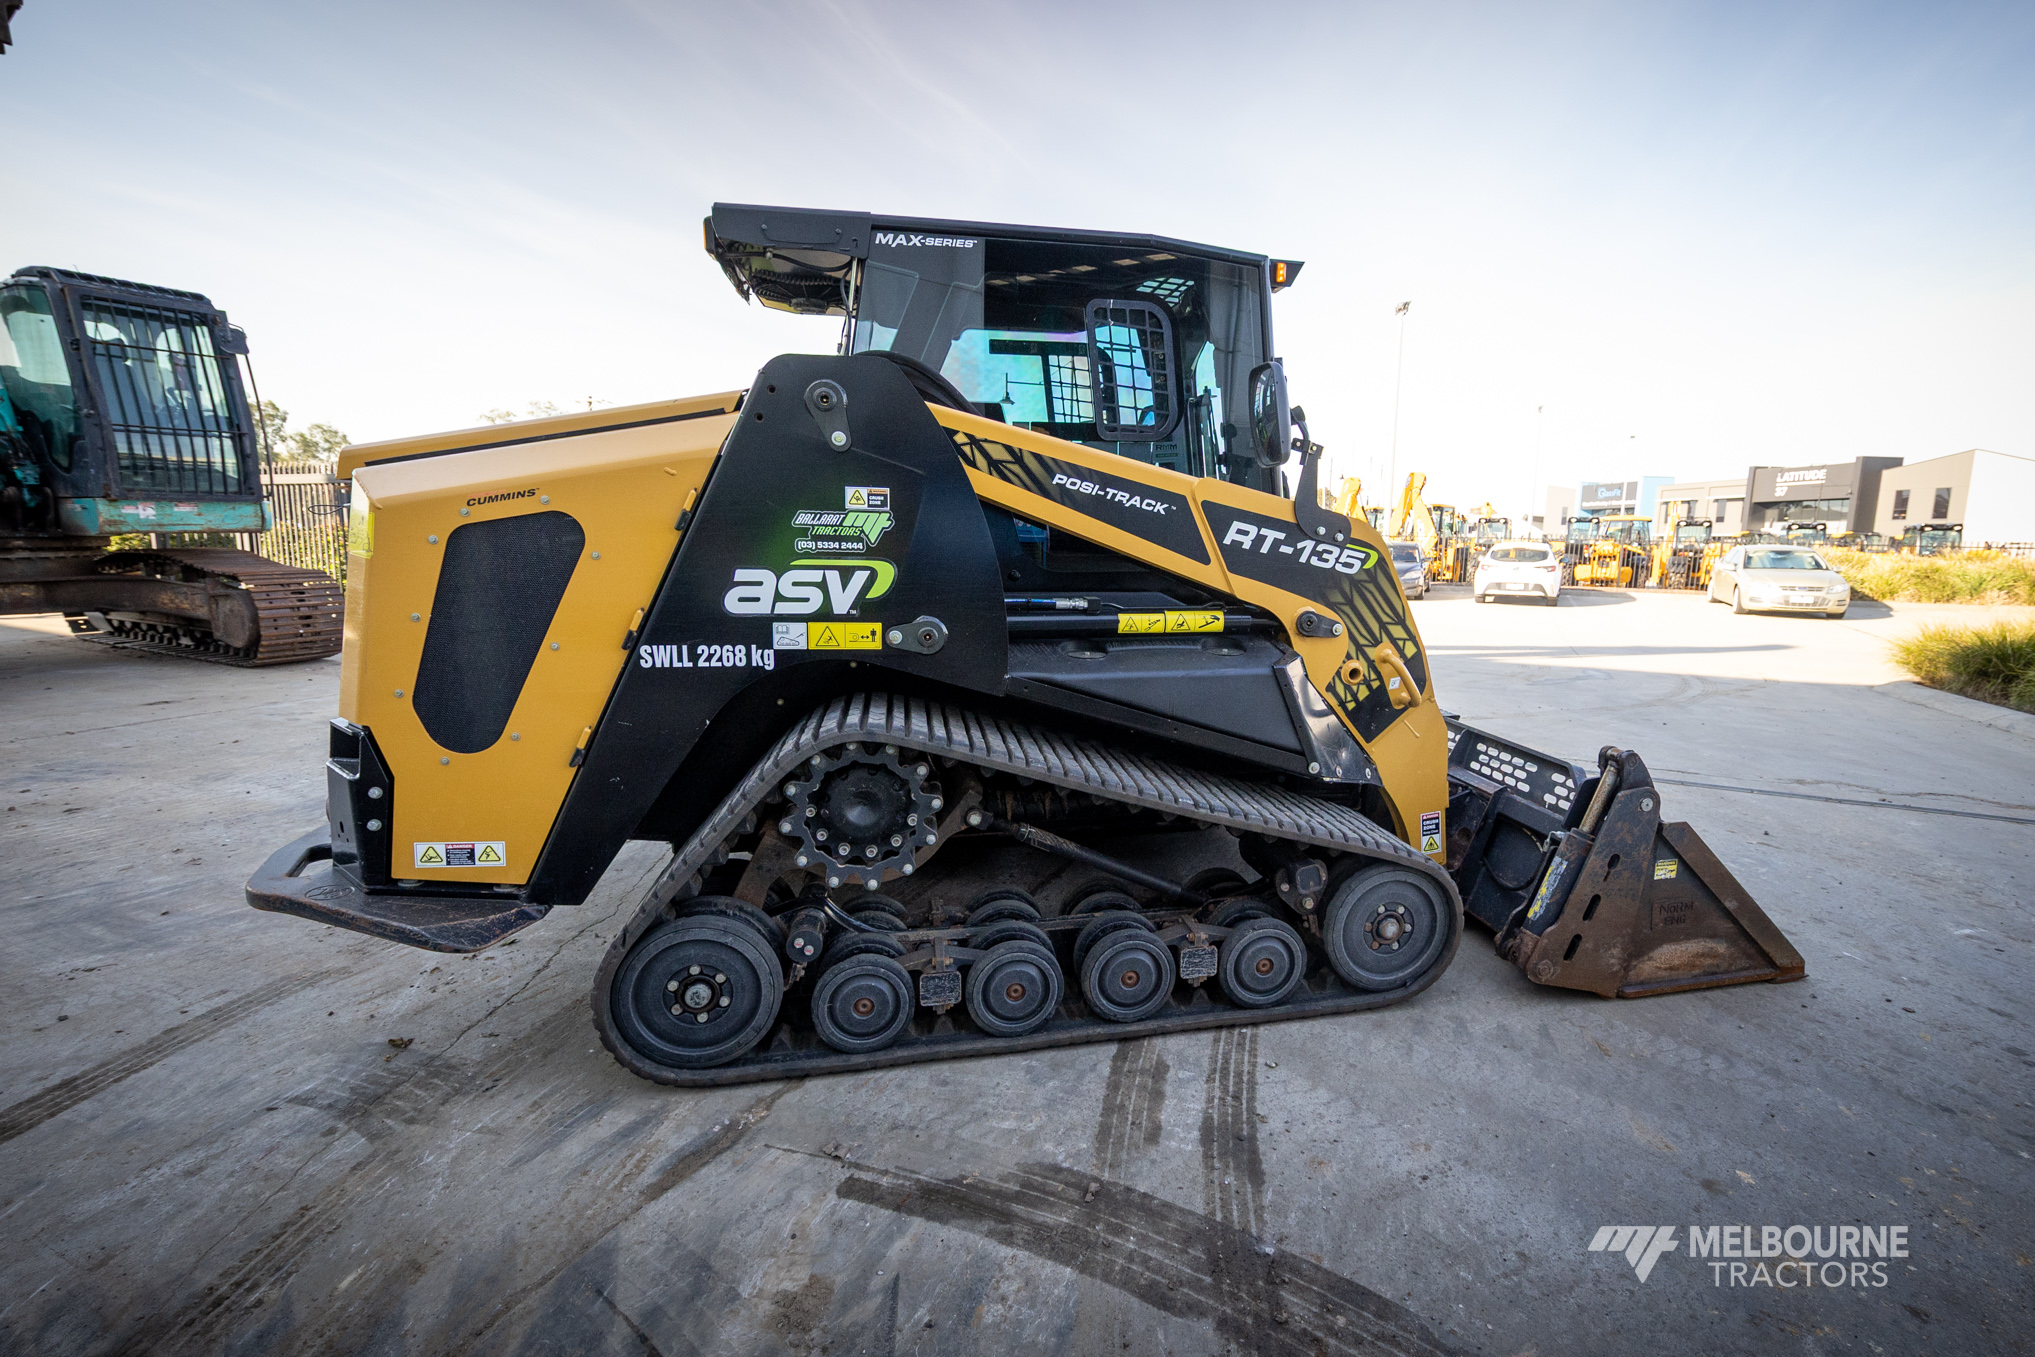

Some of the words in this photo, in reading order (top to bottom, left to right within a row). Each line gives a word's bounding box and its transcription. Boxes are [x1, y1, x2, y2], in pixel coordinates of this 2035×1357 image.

[1776, 469, 1827, 482] LATITUDE
[466, 488, 536, 506] CUMMINS
[1052, 473, 1169, 515] POSI-TRACK
[1774, 486, 1788, 497] 37
[795, 513, 845, 525] BALLARAT
[812, 526, 862, 536] TRACTORS
[798, 541, 815, 549] (03)
[1223, 521, 1366, 575] RT-135
[640, 645, 693, 668] SWLL
[697, 645, 747, 667] 2268
[751, 645, 775, 670] kg
